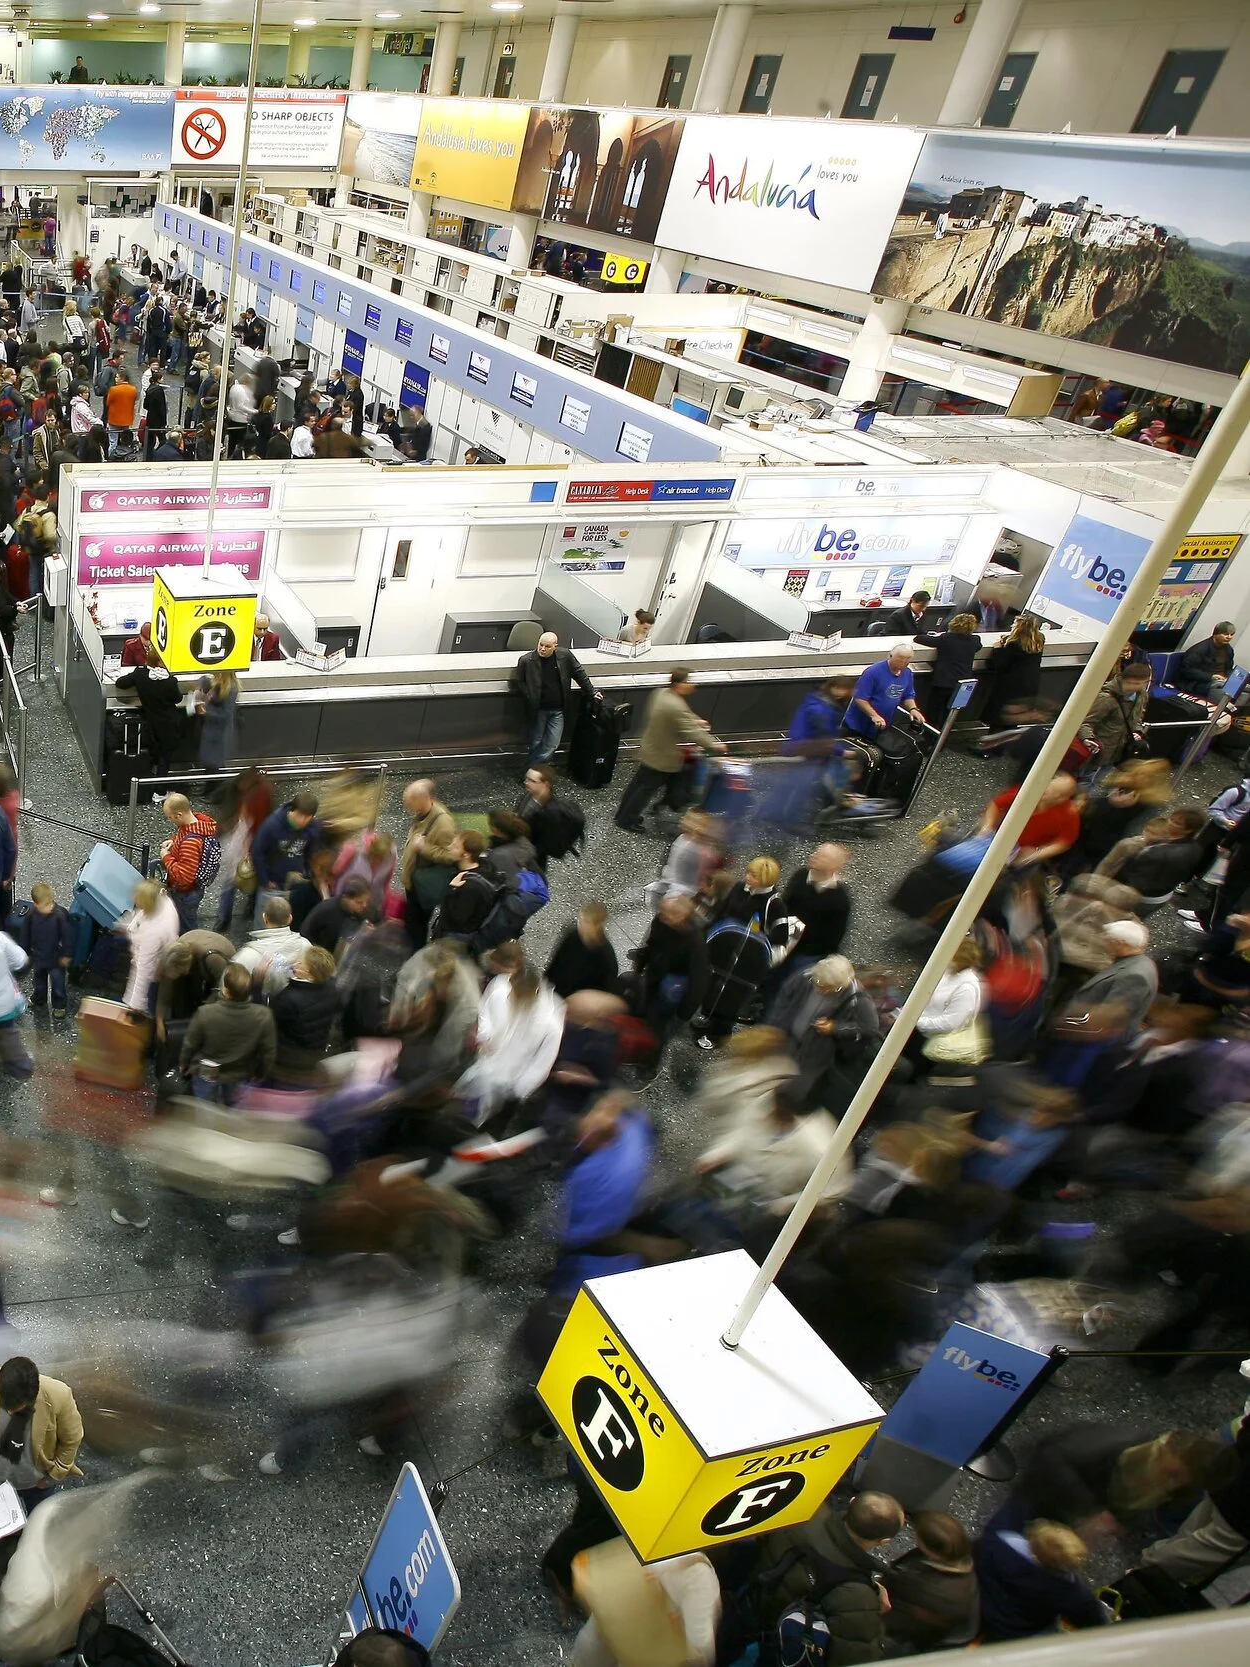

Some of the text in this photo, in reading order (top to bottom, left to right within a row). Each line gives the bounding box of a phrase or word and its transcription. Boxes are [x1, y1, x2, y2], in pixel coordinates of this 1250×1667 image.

[118, 91, 148, 99] everything
[262, 112, 293, 121] SHARP
[295, 112, 334, 122] OBJECTS
[422, 122, 516, 160] Andalusia loves you
[816, 165, 859, 184] loves you
[607, 263, 615, 276] G
[626, 265, 638, 279] G
[699, 340, 733, 350] Check-in
[570, 486, 603, 495] CANADIAN
[676, 486, 699, 494] transat
[704, 487, 715, 495] Help
[117, 496, 160, 506] QATAR
[222, 493, 264, 504] القطرية
[113, 545, 156, 554] QATAR
[216, 541, 257, 552] القطرية
[89, 565, 125, 578] Ticket
[194, 605, 237, 618] Zone
[198, 628, 227, 659] E
[596, 1335, 666, 1439] Zone
[580, 1387, 636, 1461] F
[736, 1443, 831, 1479] Zone
[716, 1478, 791, 1531] F
